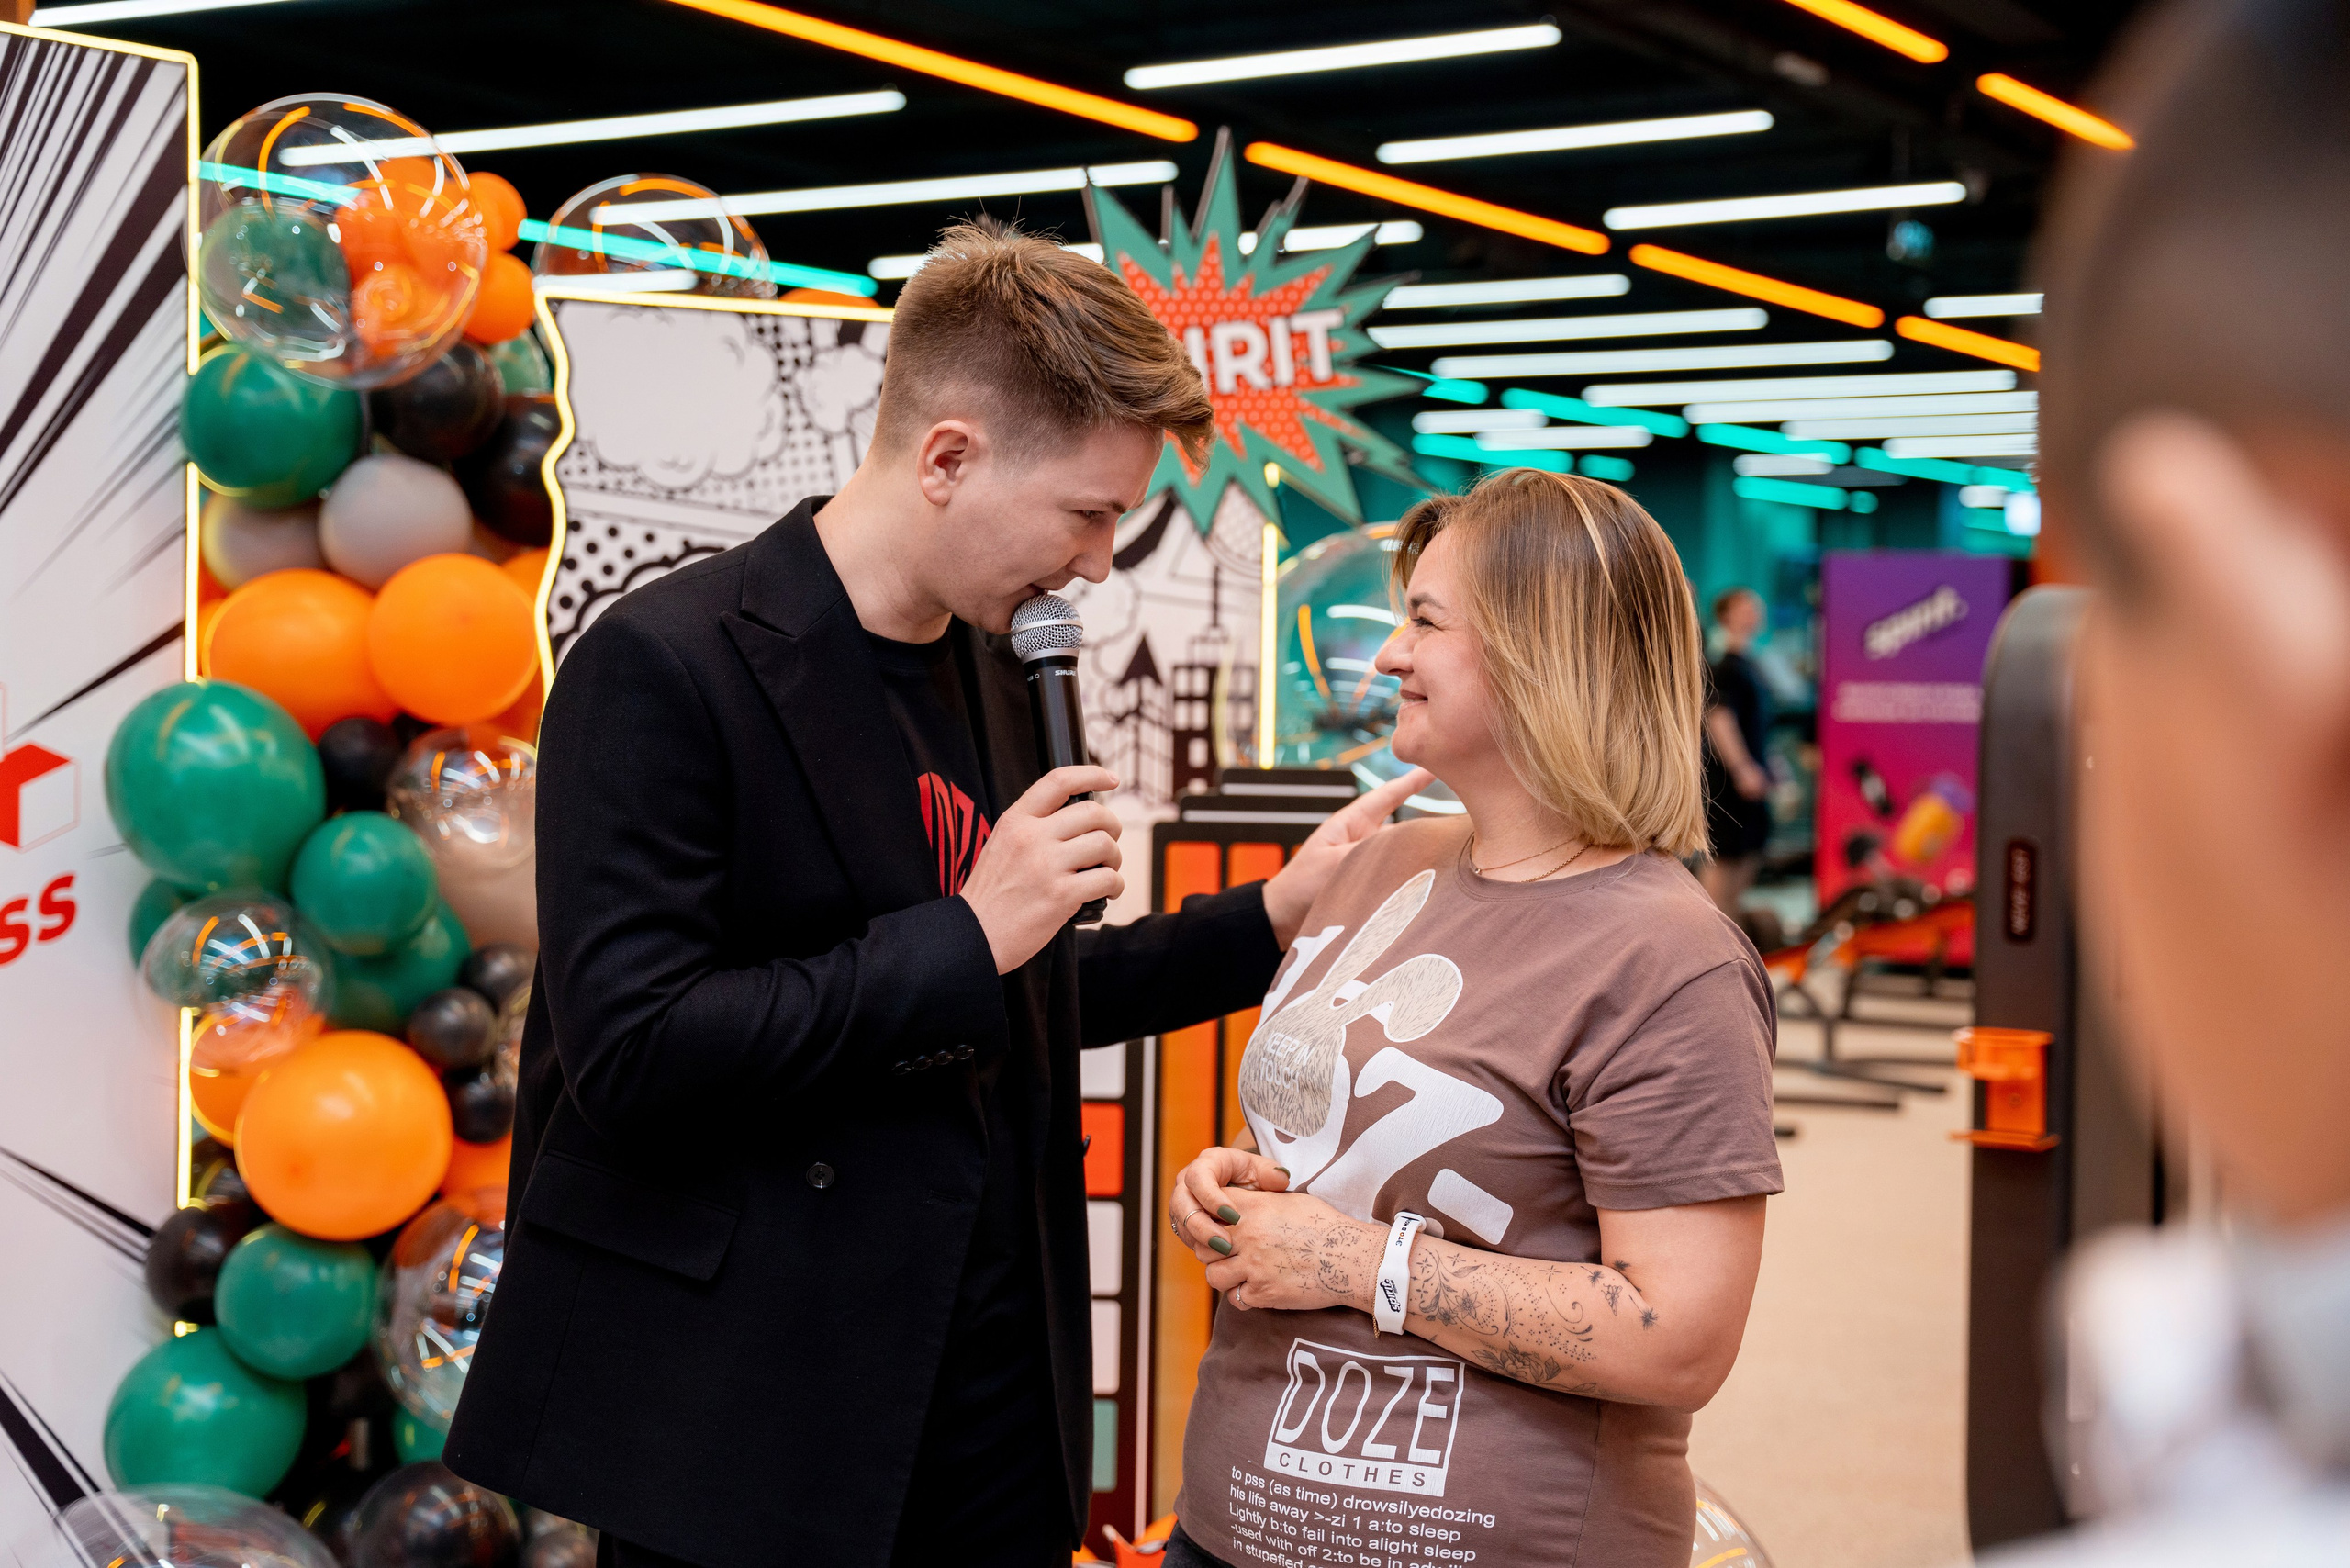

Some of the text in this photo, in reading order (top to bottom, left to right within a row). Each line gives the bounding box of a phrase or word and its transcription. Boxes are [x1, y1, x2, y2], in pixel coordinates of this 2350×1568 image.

[1184, 308, 1344, 396] IRIT
[1263, 1030, 1317, 1067] KEEP IN
[1260, 1057, 1301, 1093] TOUCH
[1274, 1349, 1455, 1465] DOZE
[1279, 1452, 1426, 1487] CLOTHES
[1230, 1484, 1246, 1501] his
[1248, 1490, 1266, 1508] life
[1270, 1501, 1309, 1523] away
[1353, 1516, 1360, 1529] 1
[1369, 1519, 1403, 1534] a:to
[1409, 1523, 1460, 1543] sleep
[1232, 1466, 1495, 1529] to pss (as time) drowsilyedozing
[1229, 1502, 1476, 1563] Lightly b:to fail into alight sleep
[1230, 1524, 1262, 1542] -used
[1266, 1535, 1292, 1552] with
[1297, 1544, 1317, 1558] off
[1322, 1548, 1354, 1564] 2:to
[1360, 1552, 1382, 1567] be
[1233, 1537, 1304, 1568] in stupefied
